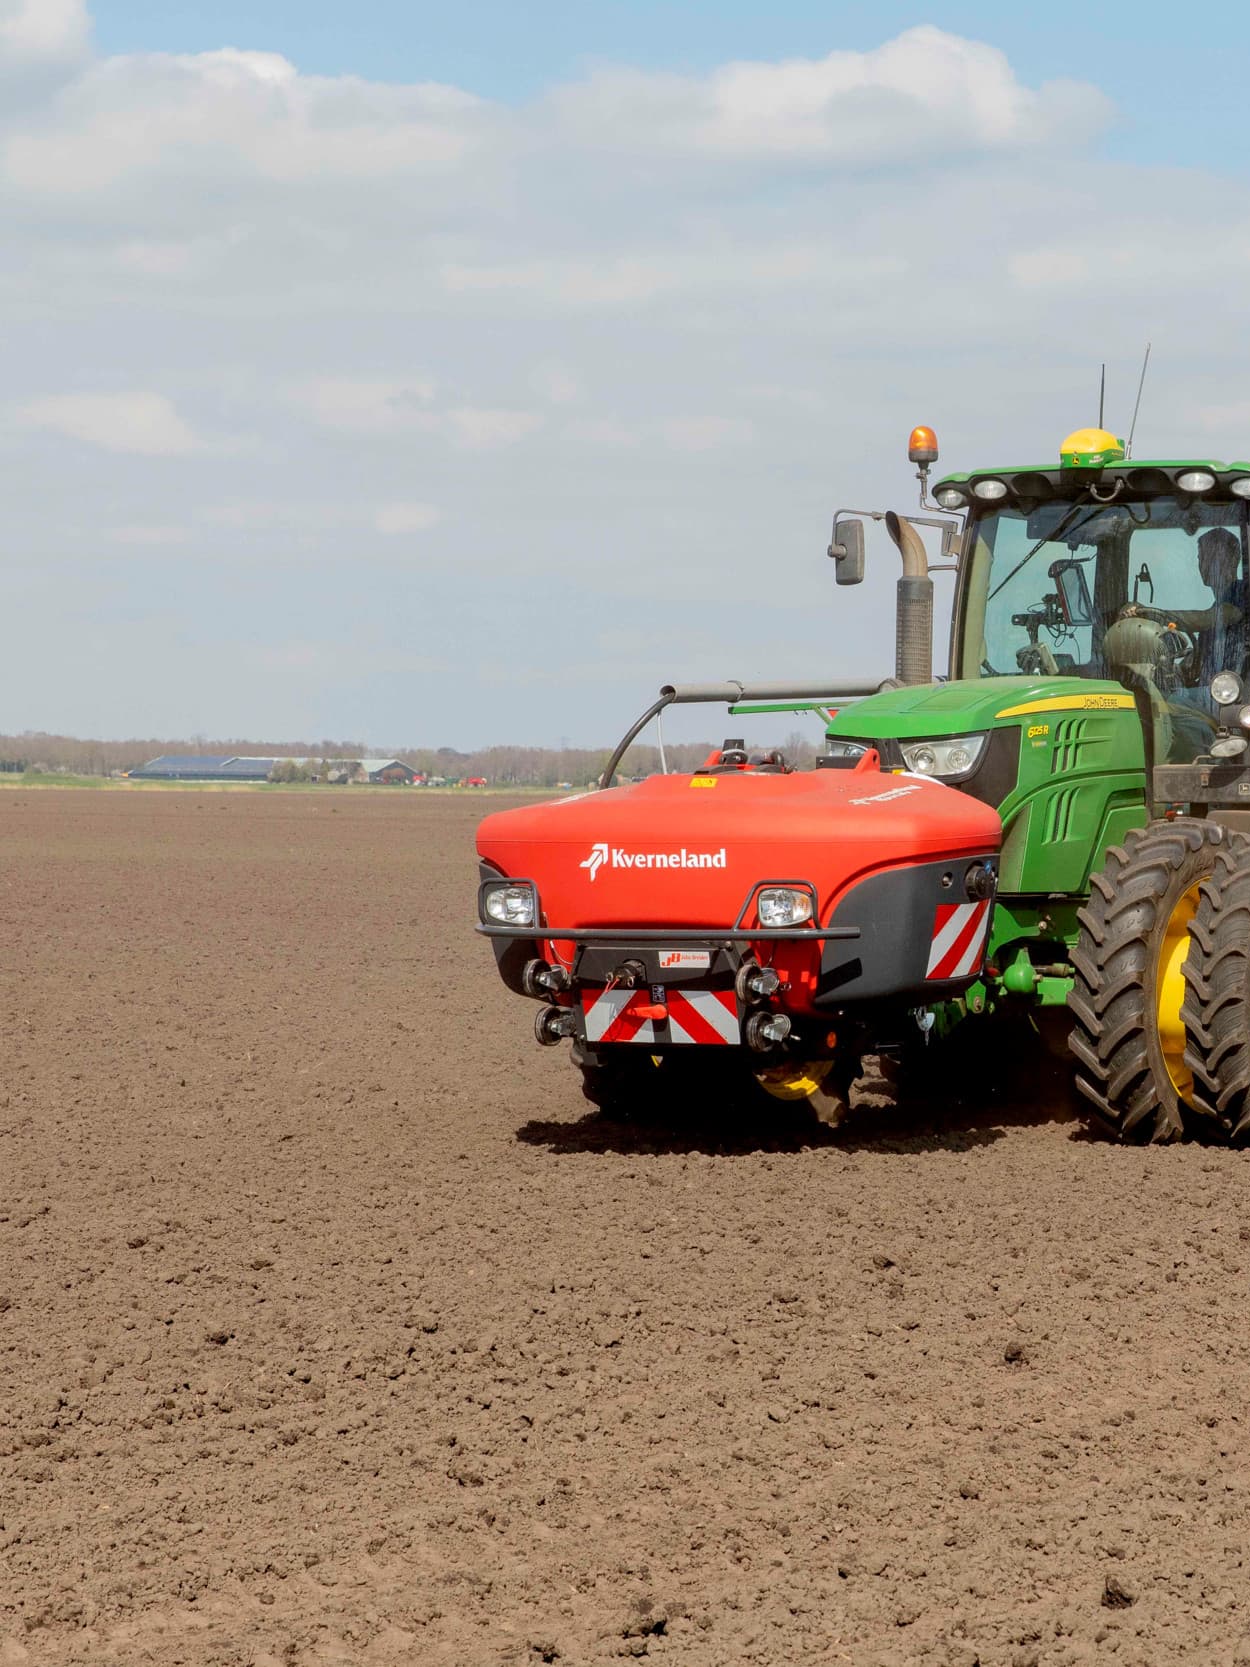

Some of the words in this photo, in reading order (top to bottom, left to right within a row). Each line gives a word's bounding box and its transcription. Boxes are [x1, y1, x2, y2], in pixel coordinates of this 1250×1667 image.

[1083, 696, 1099, 707] JOHN
[1099, 696, 1117, 707] DEERE
[612, 848, 726, 868] Kverneland
